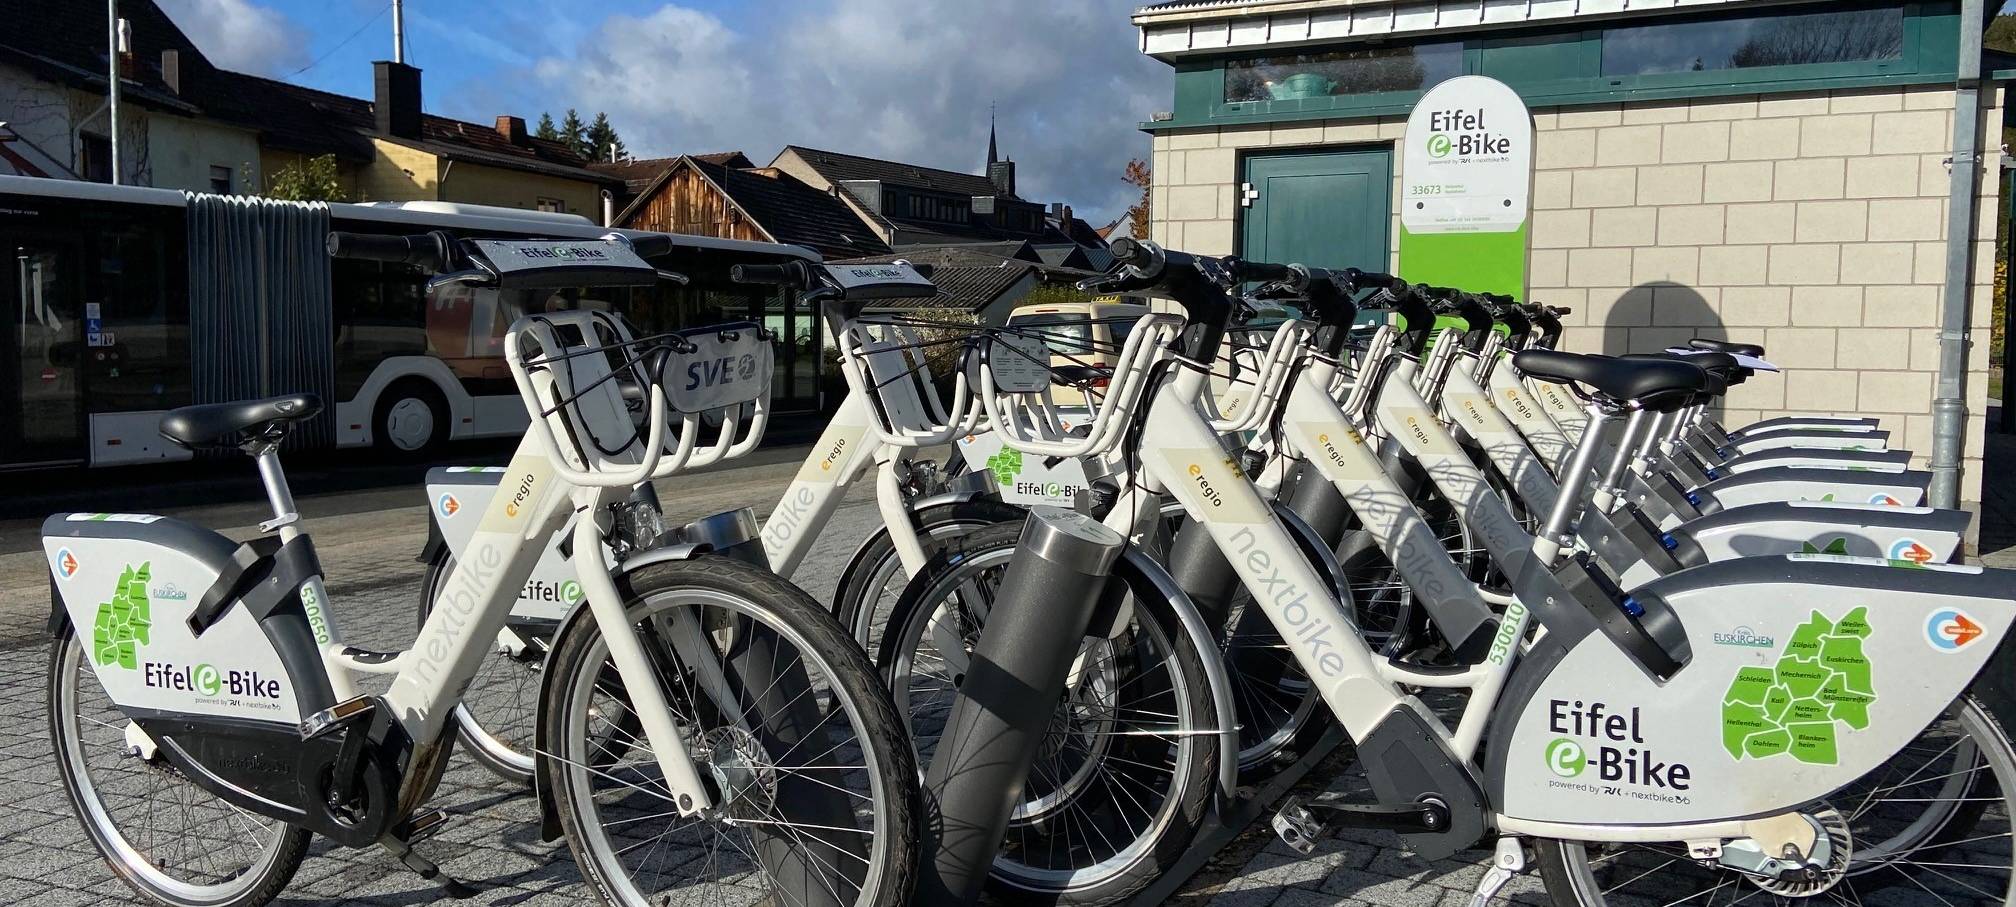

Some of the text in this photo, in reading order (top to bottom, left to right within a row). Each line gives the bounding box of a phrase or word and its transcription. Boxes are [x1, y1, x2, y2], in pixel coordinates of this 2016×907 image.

[1430, 108, 1485, 132] Eifel
[1427, 133, 1510, 158] e-Bike
[1411, 185, 1441, 195] 33673
[520, 247, 557, 259] Eifel
[686, 356, 735, 391] SVE
[1017, 482, 1080, 498] Eifel e-Bi
[1229, 526, 1344, 677] nextbike
[301, 587, 329, 645] 530659
[414, 543, 500, 686] nextbike
[1489, 602, 1524, 666] 530610
[1714, 633, 1774, 646] EUSKIRCHEN
[1792, 641, 1818, 649] Zülpich
[1826, 656, 1864, 664] Euskirchen
[145, 662, 193, 692] Eifel
[1738, 675, 1772, 683] Schleiden
[1780, 671, 1822, 680] Mechernich
[1823, 694, 1868, 703] Münstereifel
[1795, 705, 1824, 713] Netters-
[1550, 699, 1644, 744] Eifel
[1726, 719, 1762, 727] Hellenthal
[1752, 740, 1780, 748] Dahlem
[1798, 734, 1828, 742] Blanken-
[1545, 738, 1691, 791] e-Bike
[1549, 779, 1587, 792] powered
[1589, 785, 1600, 795] by
[1631, 791, 1675, 804] nextbike
